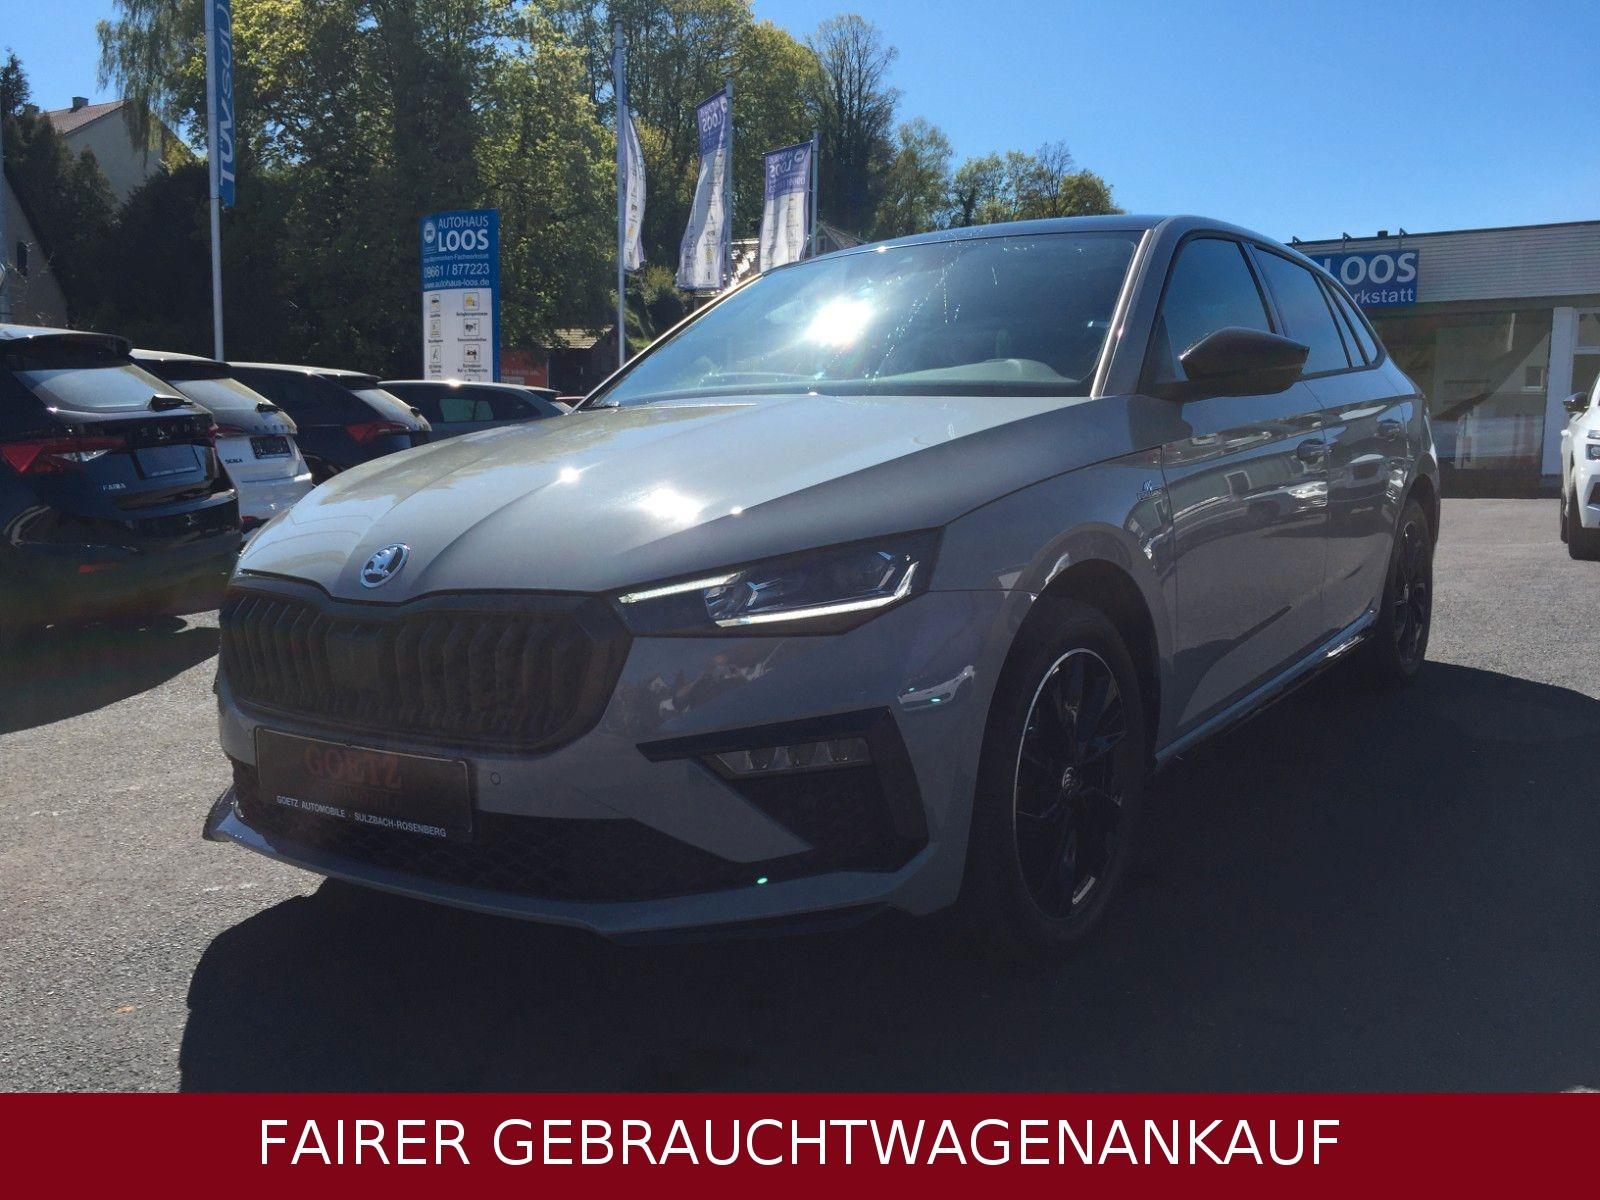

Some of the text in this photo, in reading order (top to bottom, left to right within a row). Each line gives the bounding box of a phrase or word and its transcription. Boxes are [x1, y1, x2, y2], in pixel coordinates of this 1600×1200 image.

[438, 215, 489, 229] AUTOHAUS
[438, 229, 489, 252] LOOS
[451, 263, 490, 276] 877223
[1353, 287, 1414, 304] rkstatt
[276, 794, 447, 838] GOETZ AUTOMOBILE SULZBACH-ROSENBERG
